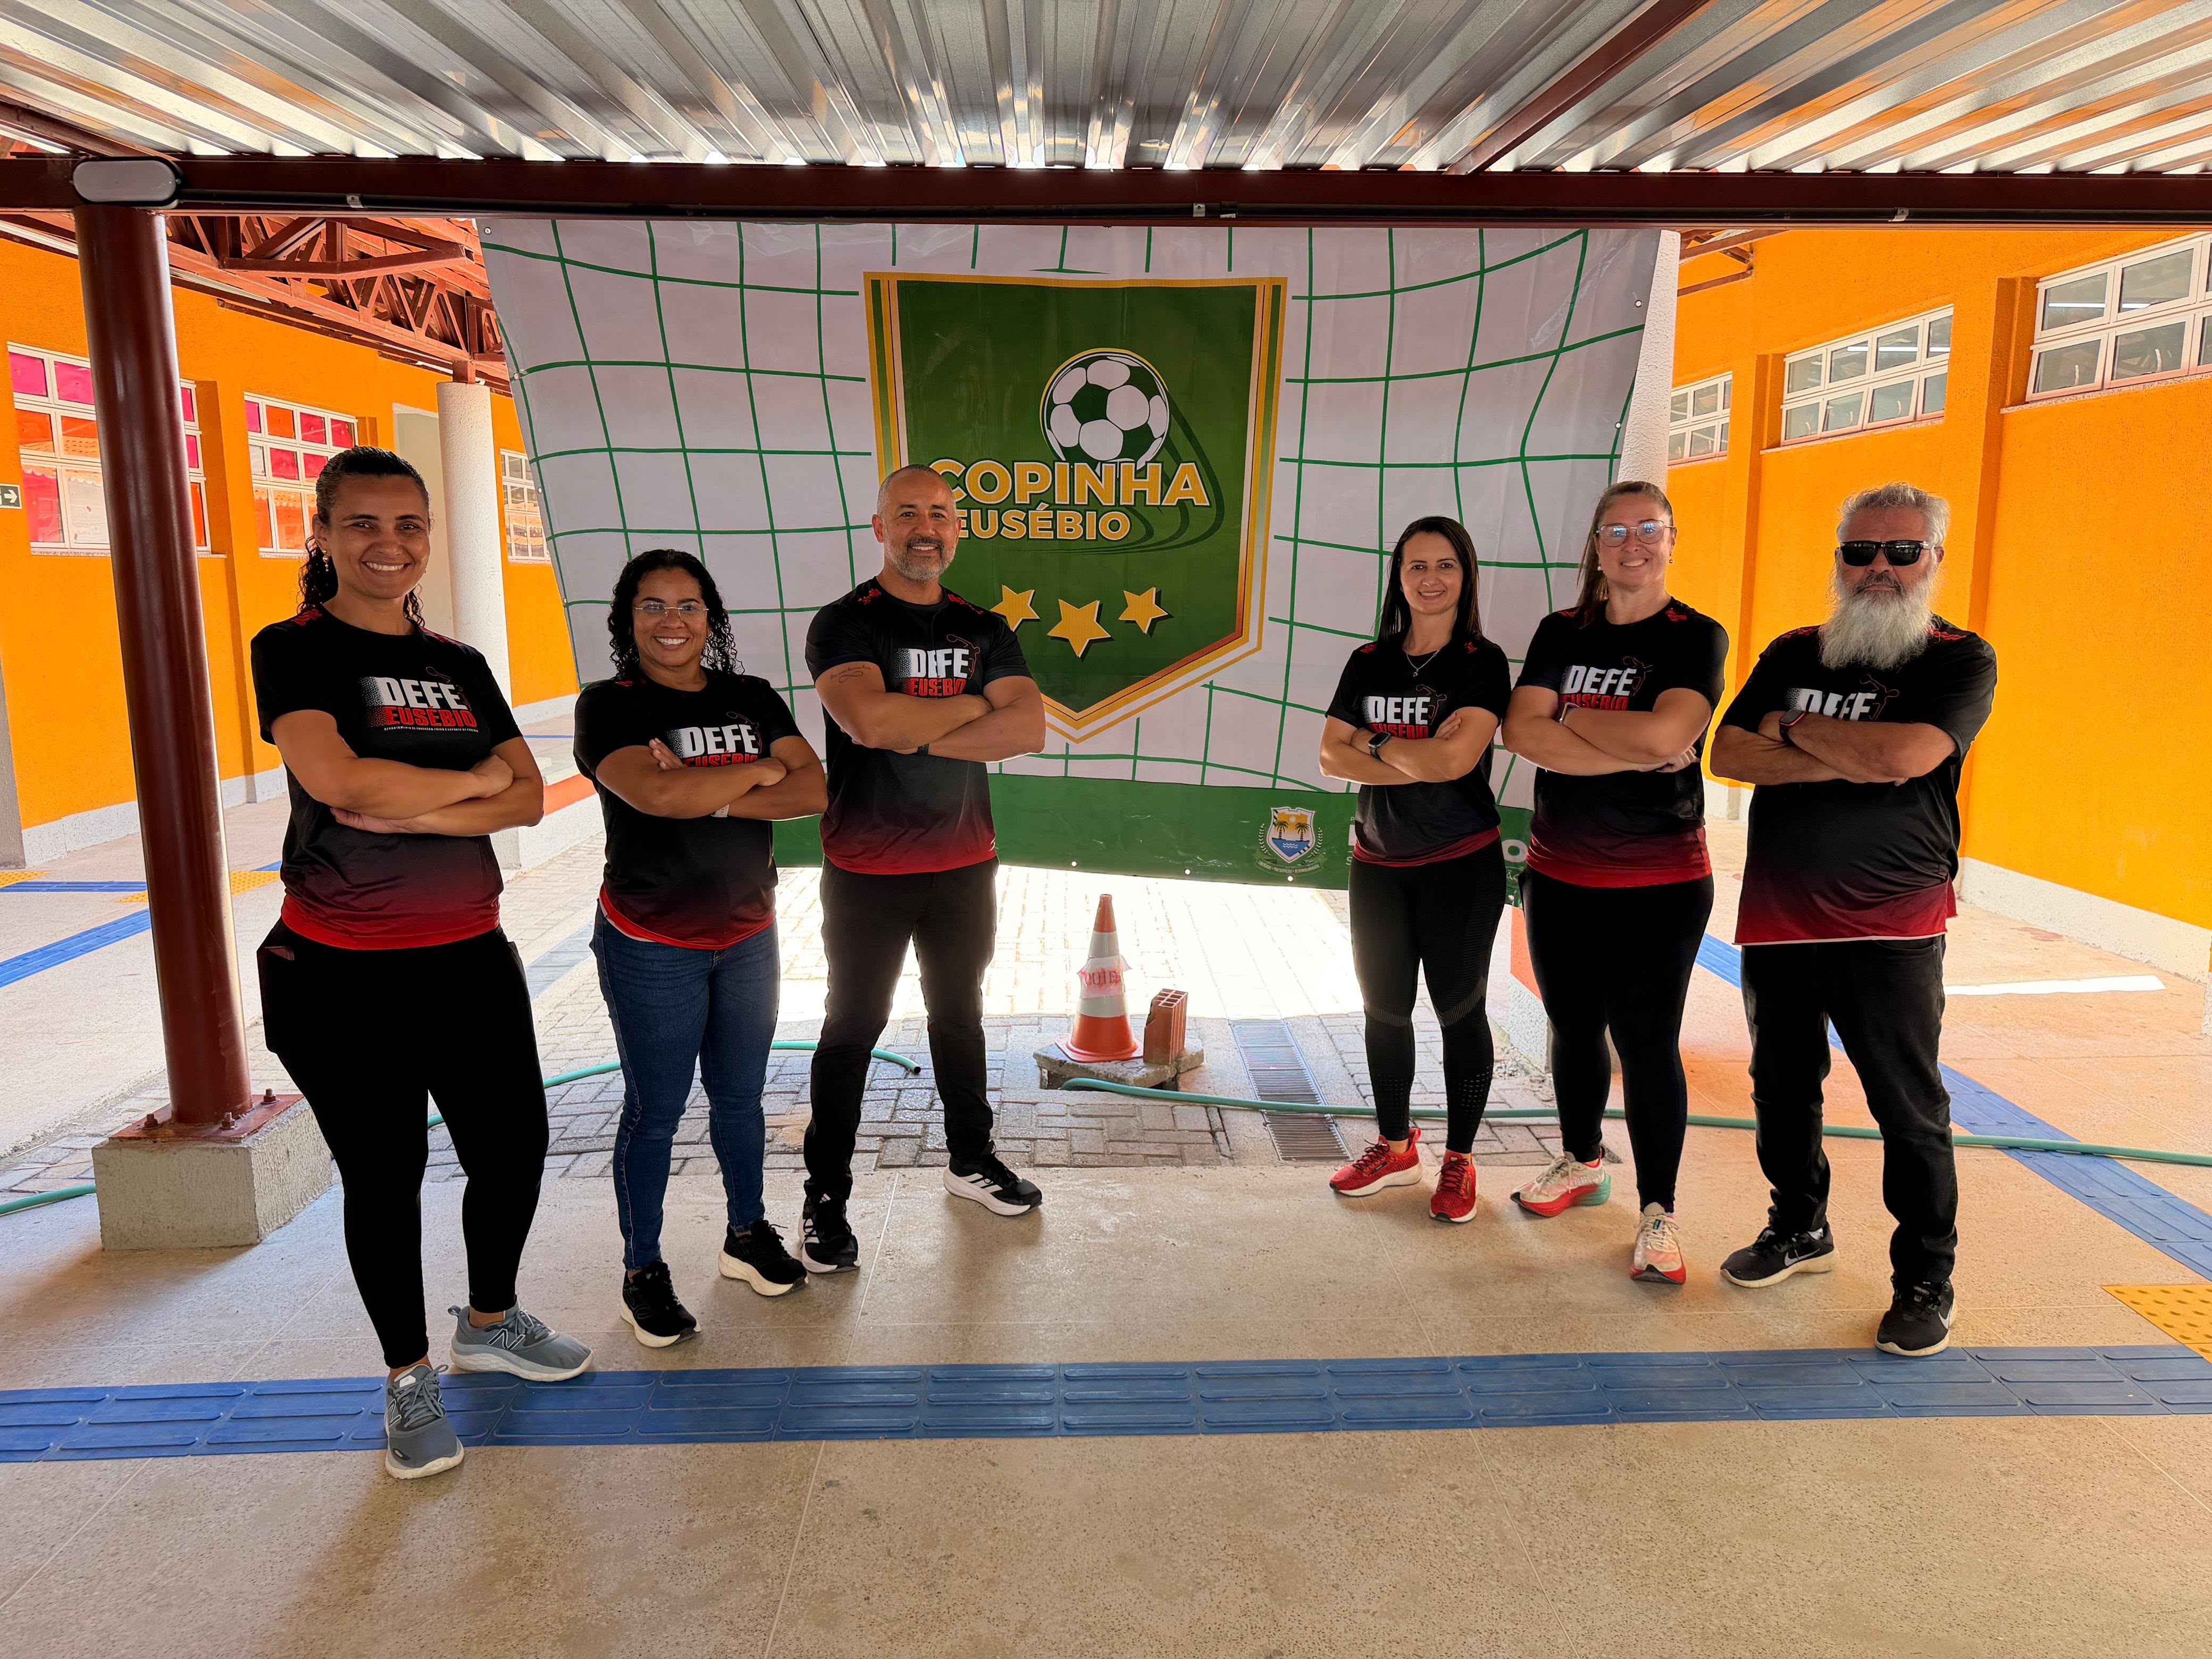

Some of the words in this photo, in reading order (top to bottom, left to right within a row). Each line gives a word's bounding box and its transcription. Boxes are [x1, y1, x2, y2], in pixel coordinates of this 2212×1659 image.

[929, 459, 1210, 506] COPINHA
[956, 502, 1130, 540] EUSÉBIO
[371, 676, 468, 710] DEFE
[1561, 665, 1637, 696] DEFE
[382, 706, 477, 727] EUSÉBIO
[1367, 696, 1431, 725] DEFE
[678, 724, 759, 759] DEFE
